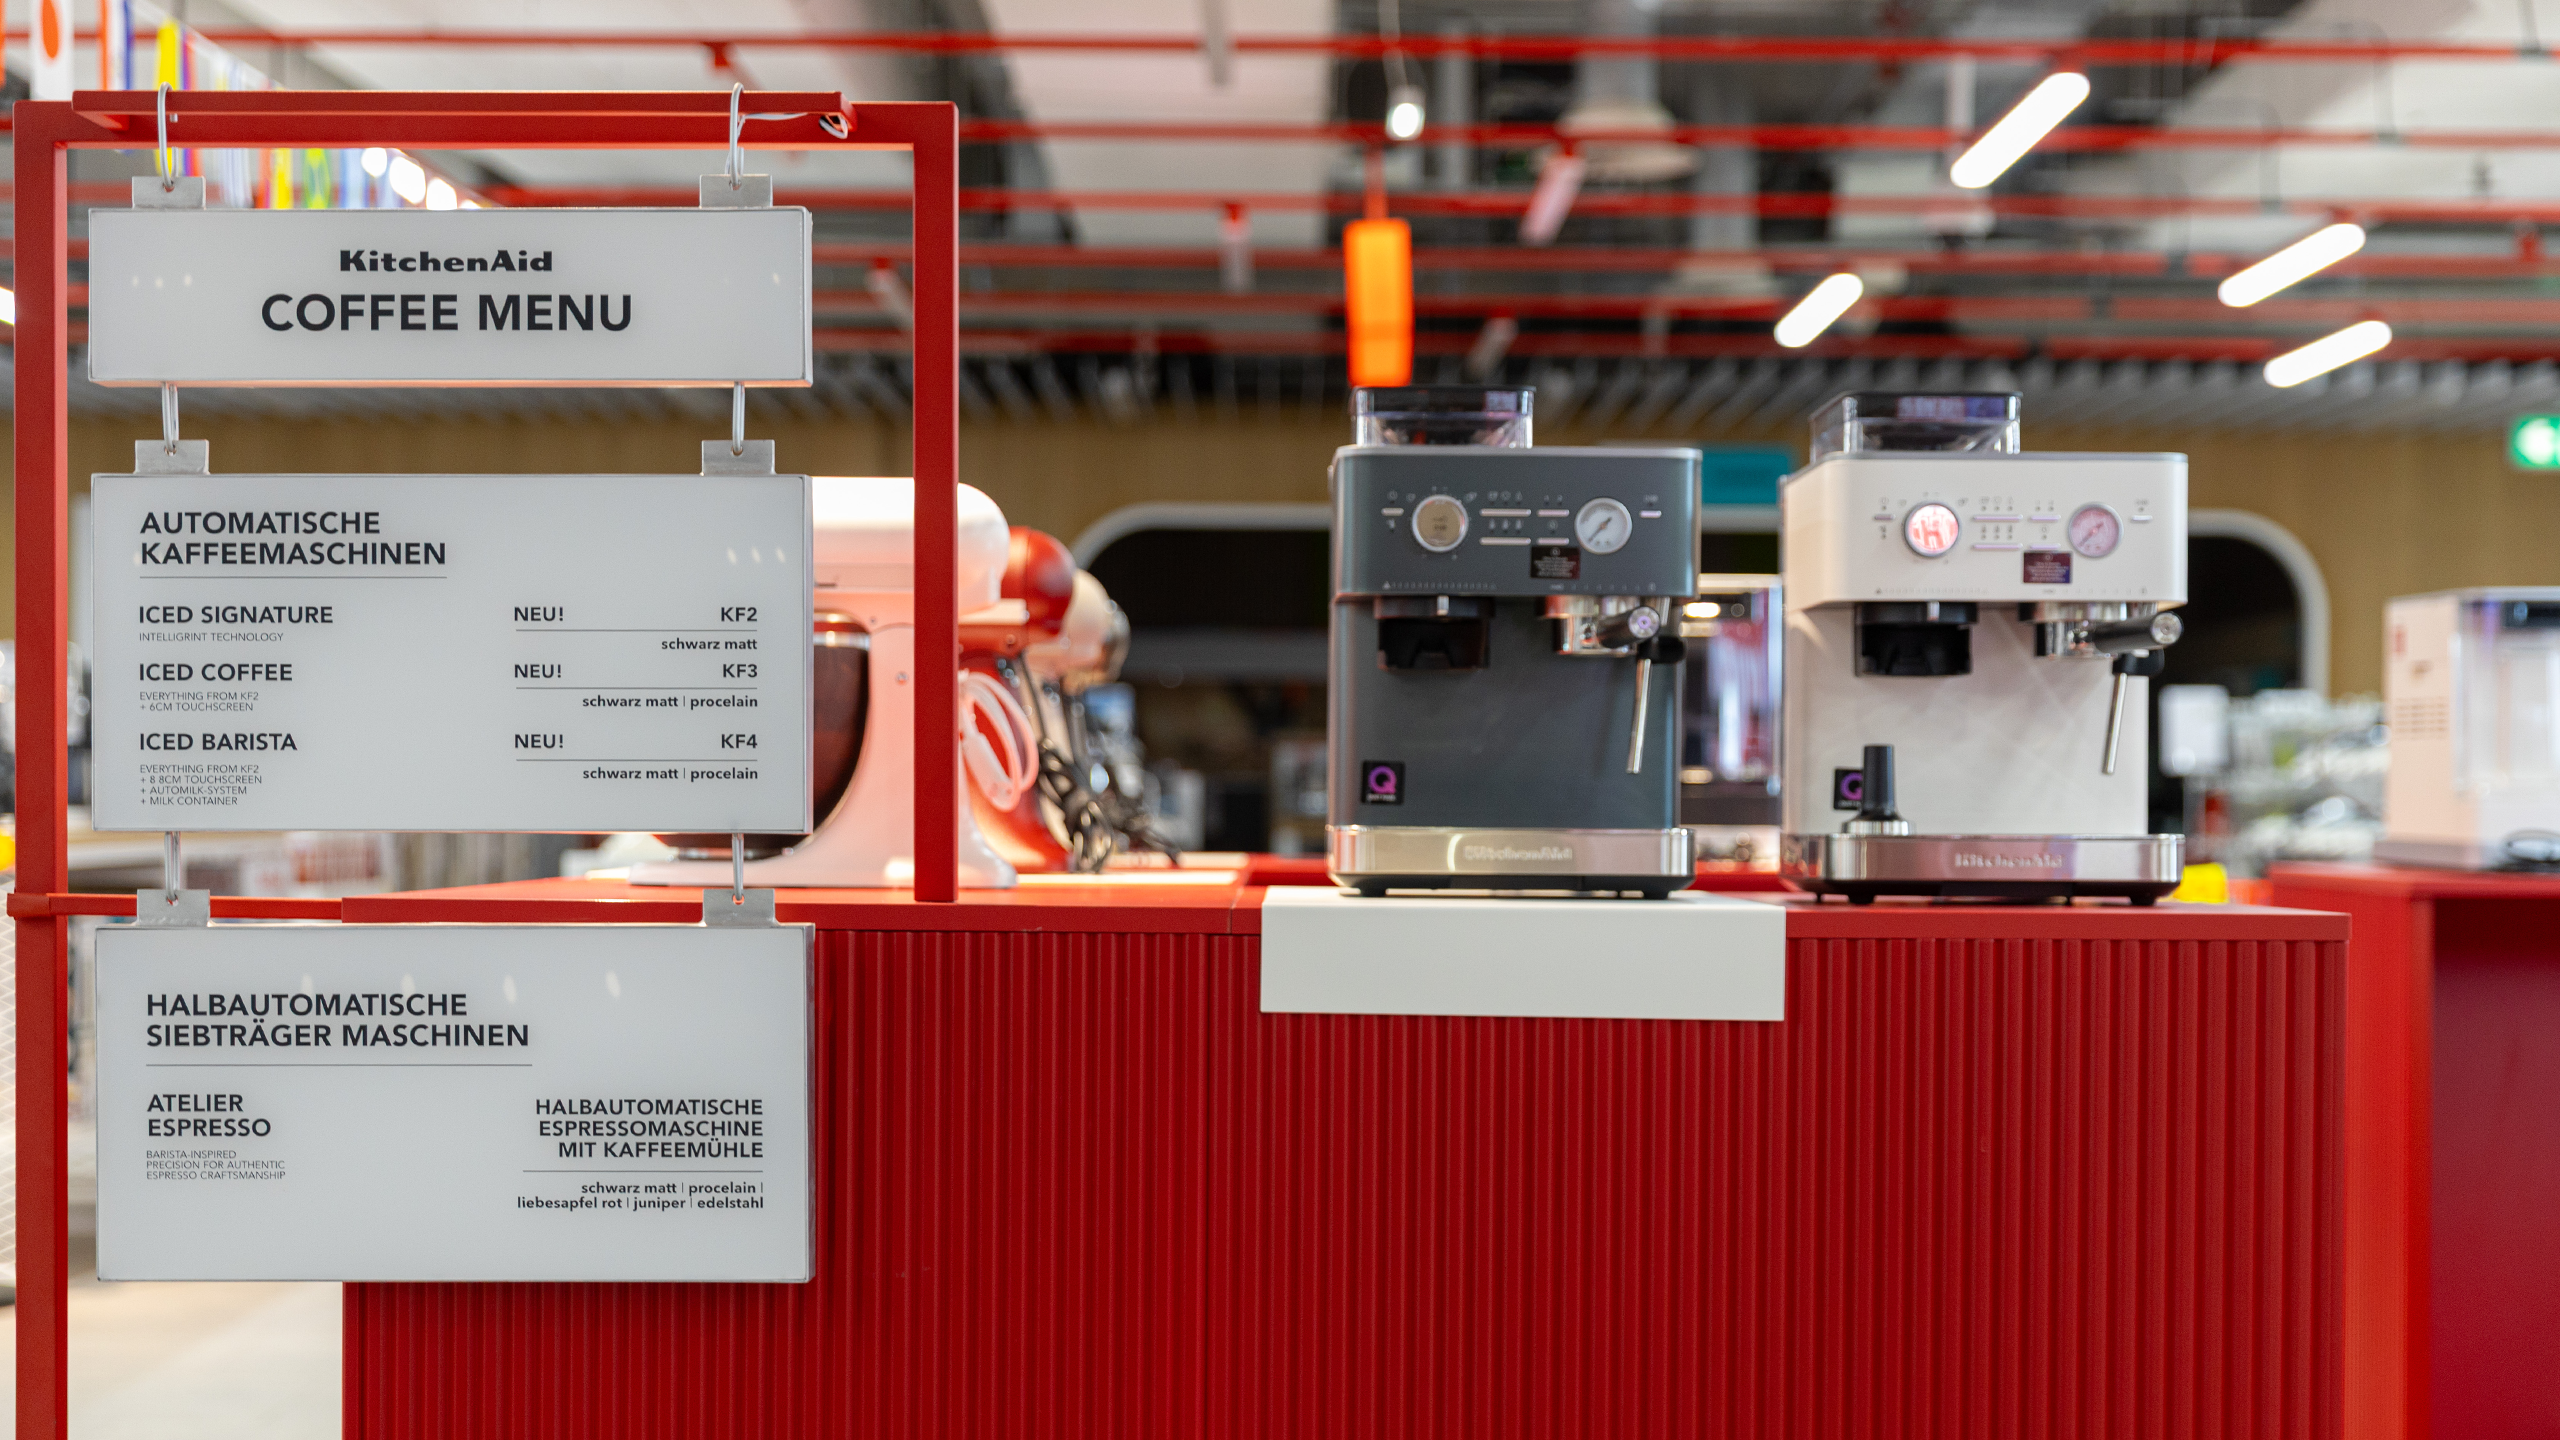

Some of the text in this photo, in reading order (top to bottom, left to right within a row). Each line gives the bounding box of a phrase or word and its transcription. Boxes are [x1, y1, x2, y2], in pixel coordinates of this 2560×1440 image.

[340, 250, 552, 272] KitchenAid
[262, 294, 631, 331] COFFEE MENU
[140, 512, 380, 534] AUTOMATISCHE
[142, 542, 445, 565] KAFFEEMASCHINEN
[140, 606, 333, 623] ICED SIGNATURE
[515, 607, 563, 621] NEU!
[721, 607, 757, 622] KF2
[139, 632, 284, 642] INTELLIGRINT TECHNOLOGY
[661, 637, 758, 650] schwarz matt
[140, 664, 292, 681] ICED COFFEE
[515, 664, 561, 678] NEU!
[723, 664, 757, 678] KF3
[139, 691, 259, 701] EVERYTHING FROM KF2
[582, 694, 642, 707] schwarz
[645, 696, 679, 708] matt
[691, 695, 757, 710] procelain
[149, 702, 173, 712] 6CM
[175, 701, 254, 712] TOUCHSCREEN
[141, 733, 297, 750] ICED BARISTA
[515, 734, 563, 748] NEU!
[722, 734, 757, 748] KF4
[139, 764, 259, 774] EVERYTHING FROM KF2
[582, 766, 642, 780] schwarz
[645, 768, 679, 780] matt
[691, 767, 757, 782] procelain
[184, 774, 262, 785] TOUCHSCREEN
[149, 785, 247, 795] AUTOMILK-SYSTEM
[149, 796, 175, 806] MILK
[176, 796, 238, 806] CONTAINER
[148, 994, 467, 1016] HALBAUTOMATISCHE
[147, 1018, 528, 1047] SIEBTRÄGER MASCHINEN
[147, 1094, 243, 1112] ATELIER
[537, 1099, 763, 1115] HALBAUTOMATISCHE
[149, 1118, 271, 1136] ESPRESSO
[540, 1121, 763, 1136] ESPRESSOMASCHINE
[146, 1149, 237, 1160] BARISTA-INSPIRED
[559, 1138, 763, 1158] MIT KAFFEEMÜHLE
[146, 1160, 285, 1170] PRECISION FOR AUTHENTIC
[146, 1170, 286, 1180] ESPRESSO CRAFTSMANSHIP
[581, 1181, 641, 1194] schwarz
[644, 1183, 677, 1194] matt
[689, 1182, 755, 1197] procelain
[518, 1196, 597, 1211] liebesapfel
[601, 1198, 623, 1209] rot
[633, 1197, 686, 1211] juniper
[697, 1196, 764, 1209] edelstahl
